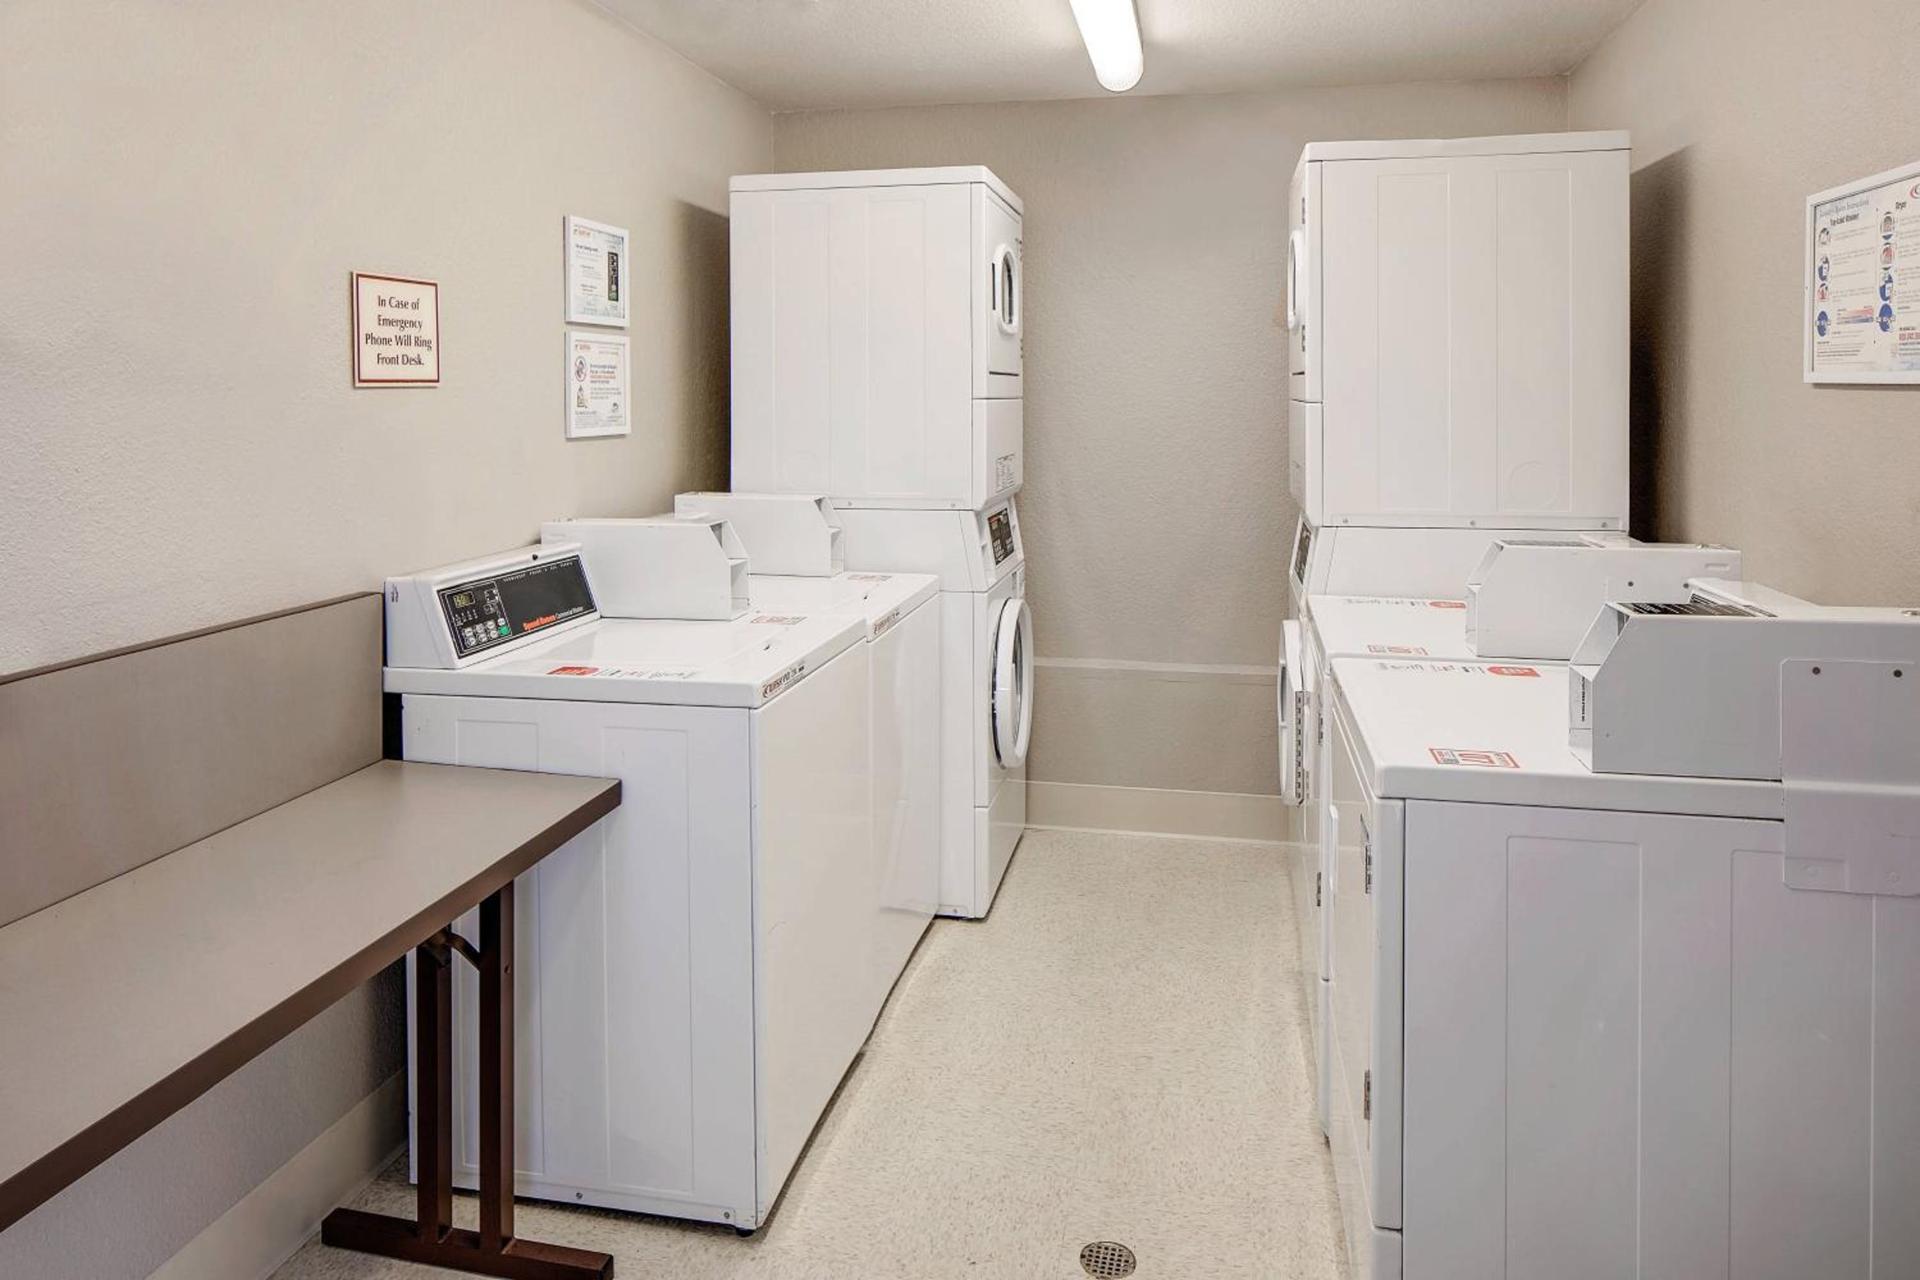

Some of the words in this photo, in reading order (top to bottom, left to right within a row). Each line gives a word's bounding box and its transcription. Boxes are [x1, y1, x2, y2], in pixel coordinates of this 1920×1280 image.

[378, 296, 386, 307] In
[388, 296, 410, 309] Case
[411, 298, 420, 310] of
[377, 315, 423, 331] Emergency
[365, 332, 393, 346] Phone
[394, 334, 412, 347] Will
[414, 335, 432, 351] Ring
[377, 353, 399, 365] Front
[402, 354, 424, 365] Desk.
